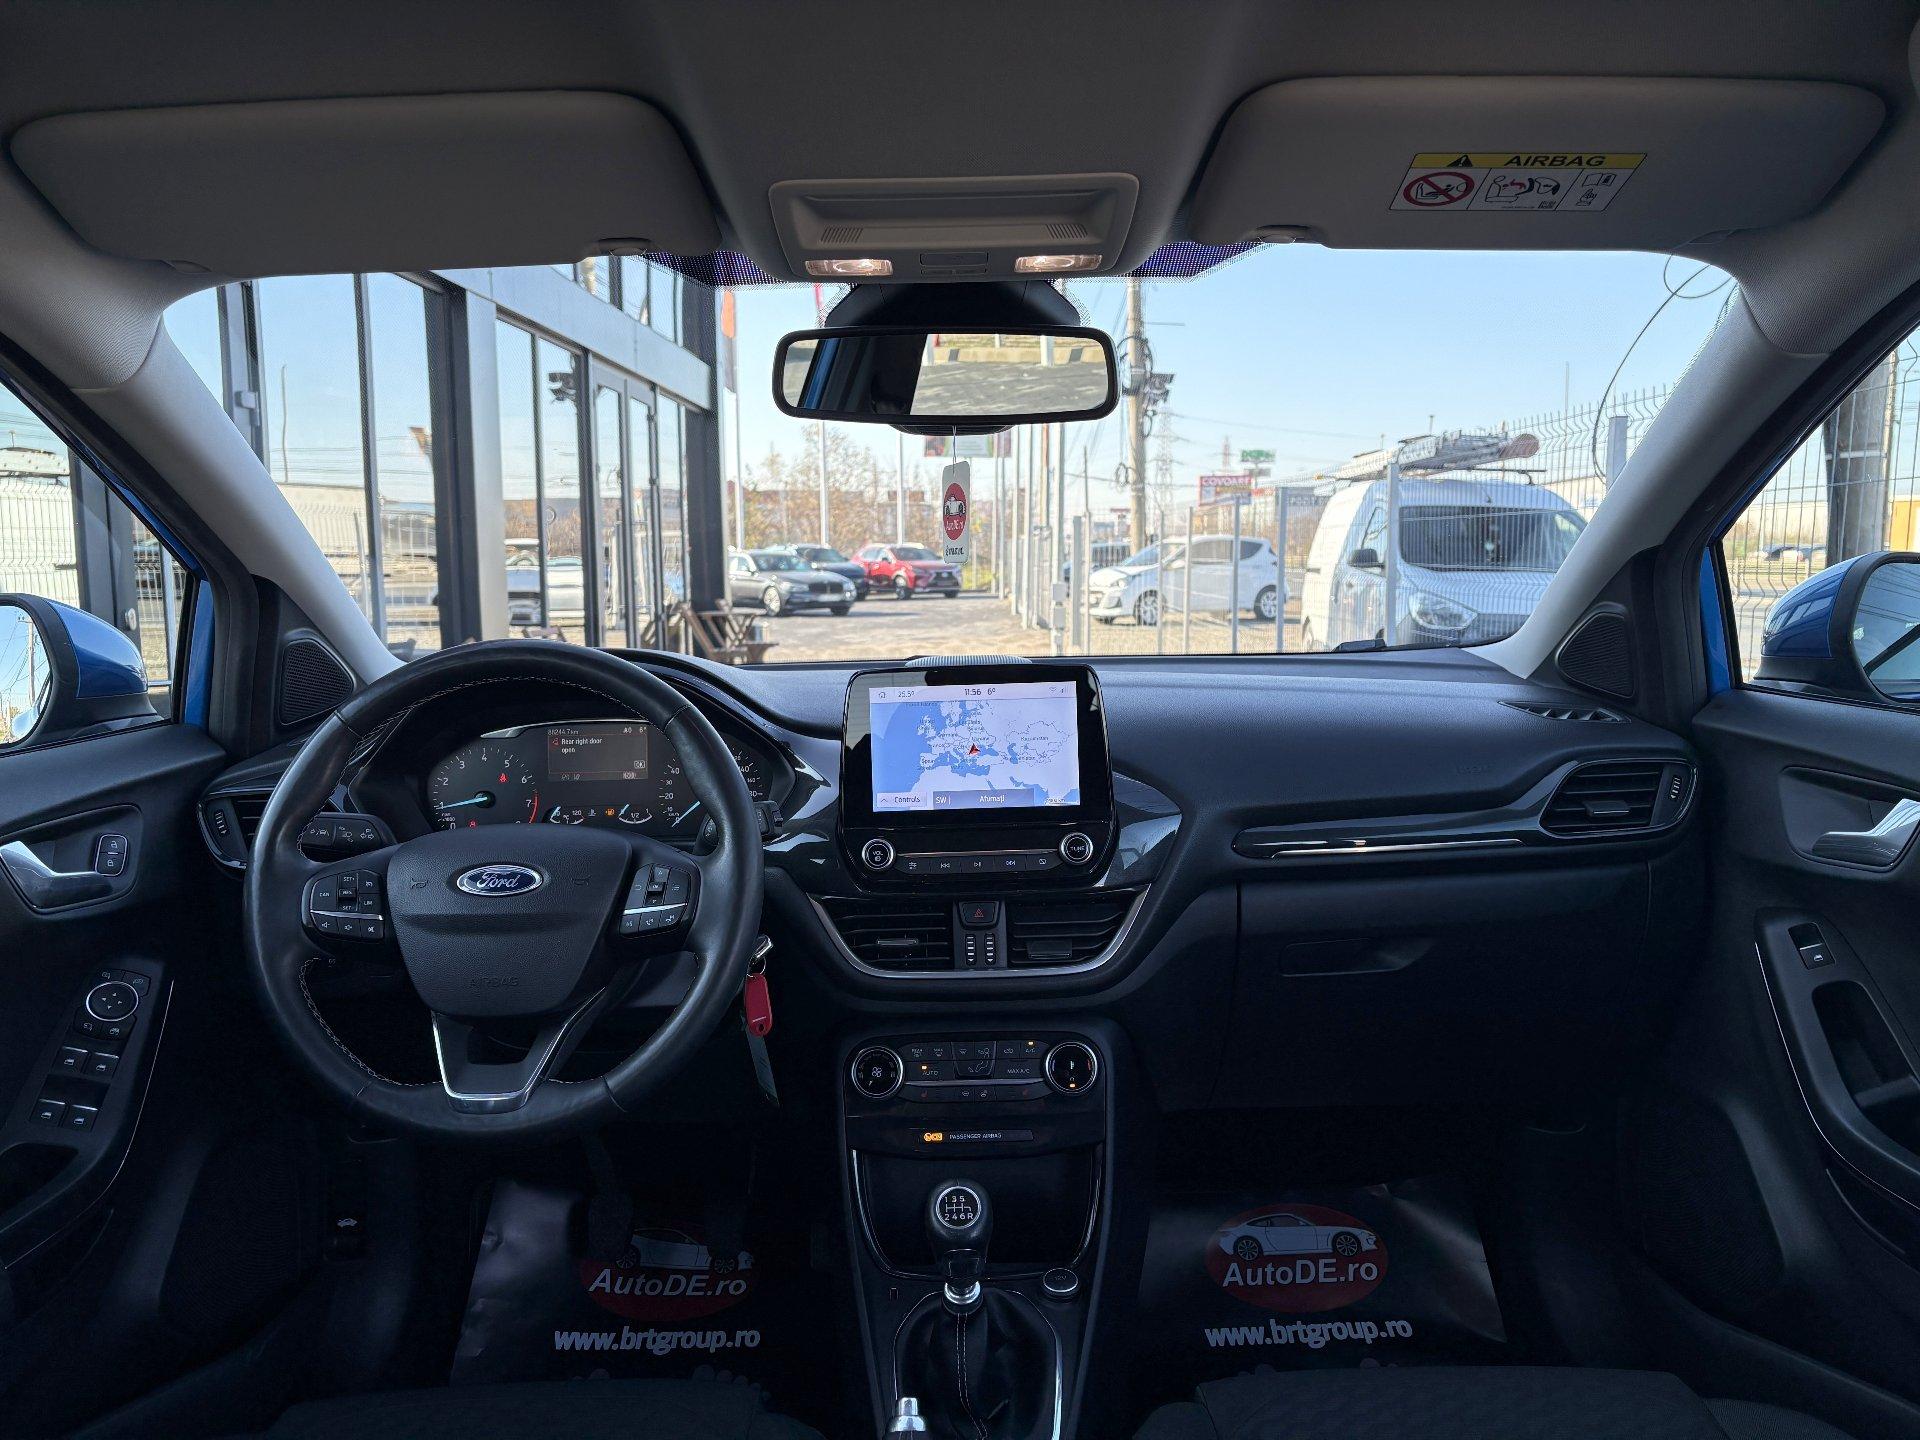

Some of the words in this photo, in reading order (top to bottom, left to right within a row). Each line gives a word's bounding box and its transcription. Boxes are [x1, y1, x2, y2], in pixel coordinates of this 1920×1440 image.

[1504, 155, 1607, 167] AIRBAG
[964, 688, 982, 696] 11:56
[576, 738, 588, 748] right
[590, 737, 602, 745] door
[562, 747, 576, 755] open
[481, 753, 487, 762] 4
[459, 761, 466, 769] 3
[504, 759, 510, 768] 5
[671, 767, 680, 775] 40
[443, 777, 449, 786] 2
[521, 776, 528, 784] 6
[664, 792, 674, 800] 20
[894, 795, 921, 803] Controls
[526, 799, 532, 808] 7
[476, 871, 521, 888] Ford
[944, 1213, 950, 1221] 2
[952, 1212, 958, 1220] 4
[959, 1212, 966, 1220] 6
[967, 1212, 974, 1220] R
[1221, 1258, 1378, 1288] AutoDE.ro
[587, 1268, 748, 1297] AutoDE.ro
[1204, 1318, 1413, 1349] www.brtgroup.ro
[553, 1326, 761, 1356] www.brtgroup.ro
